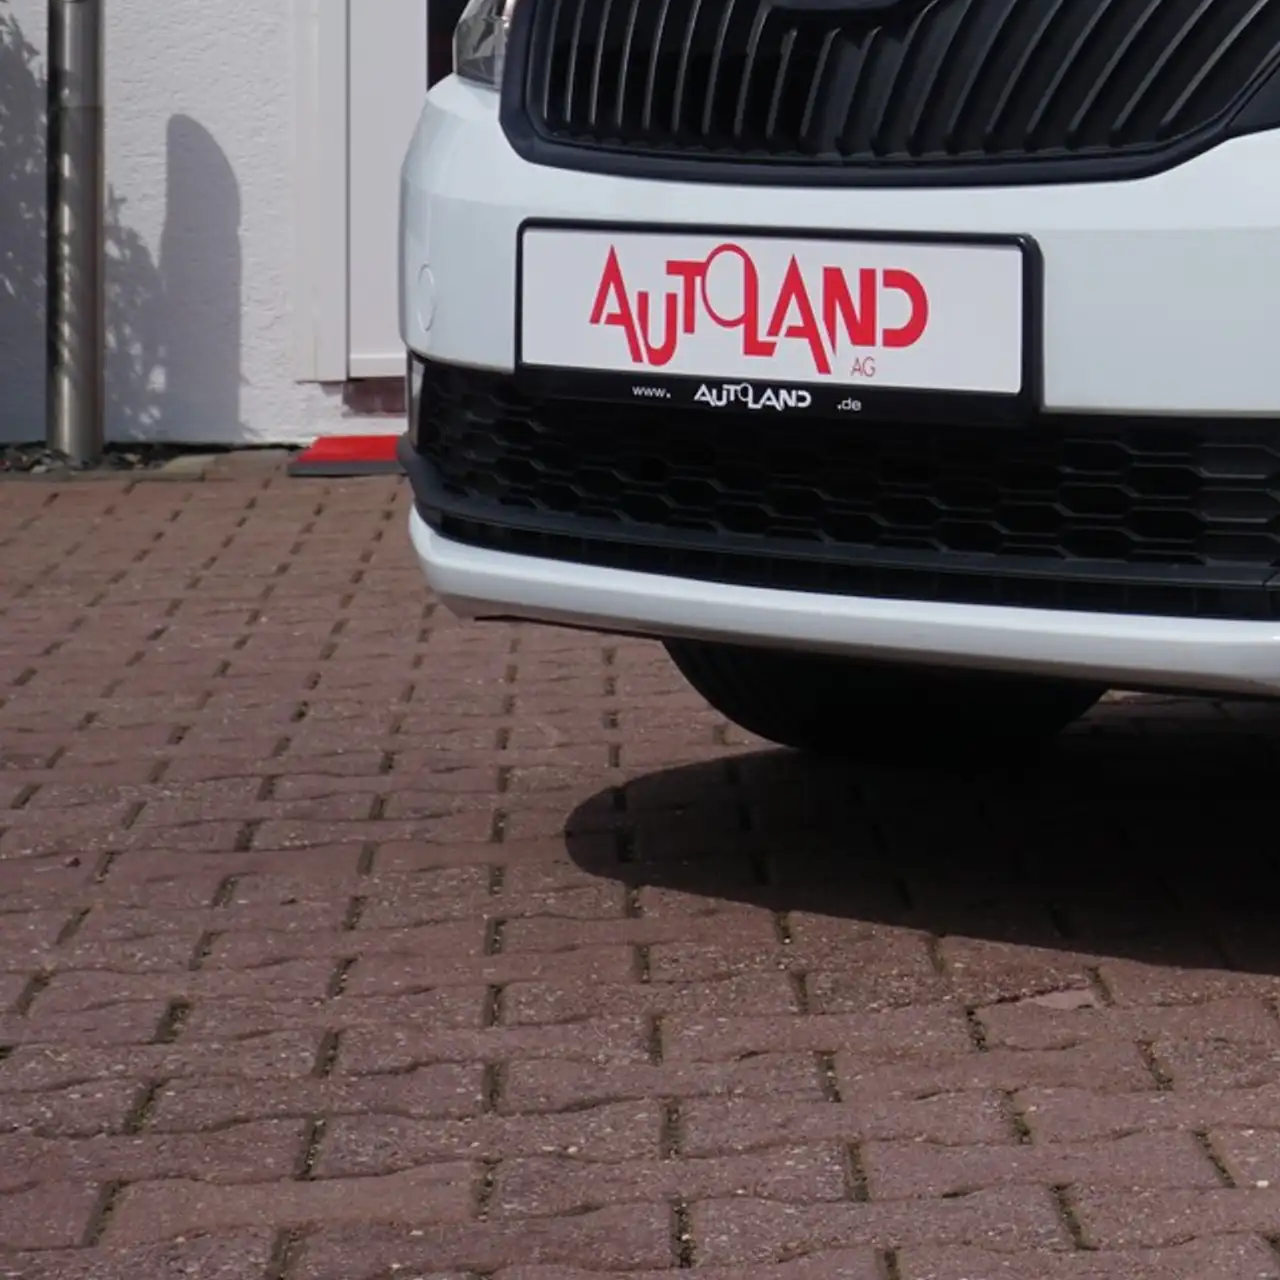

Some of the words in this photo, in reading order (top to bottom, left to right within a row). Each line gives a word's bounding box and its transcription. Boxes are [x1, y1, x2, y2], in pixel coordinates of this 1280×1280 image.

[851, 357, 876, 378] AG
[632, 386, 671, 399] www.
[837, 397, 862, 412] .de
